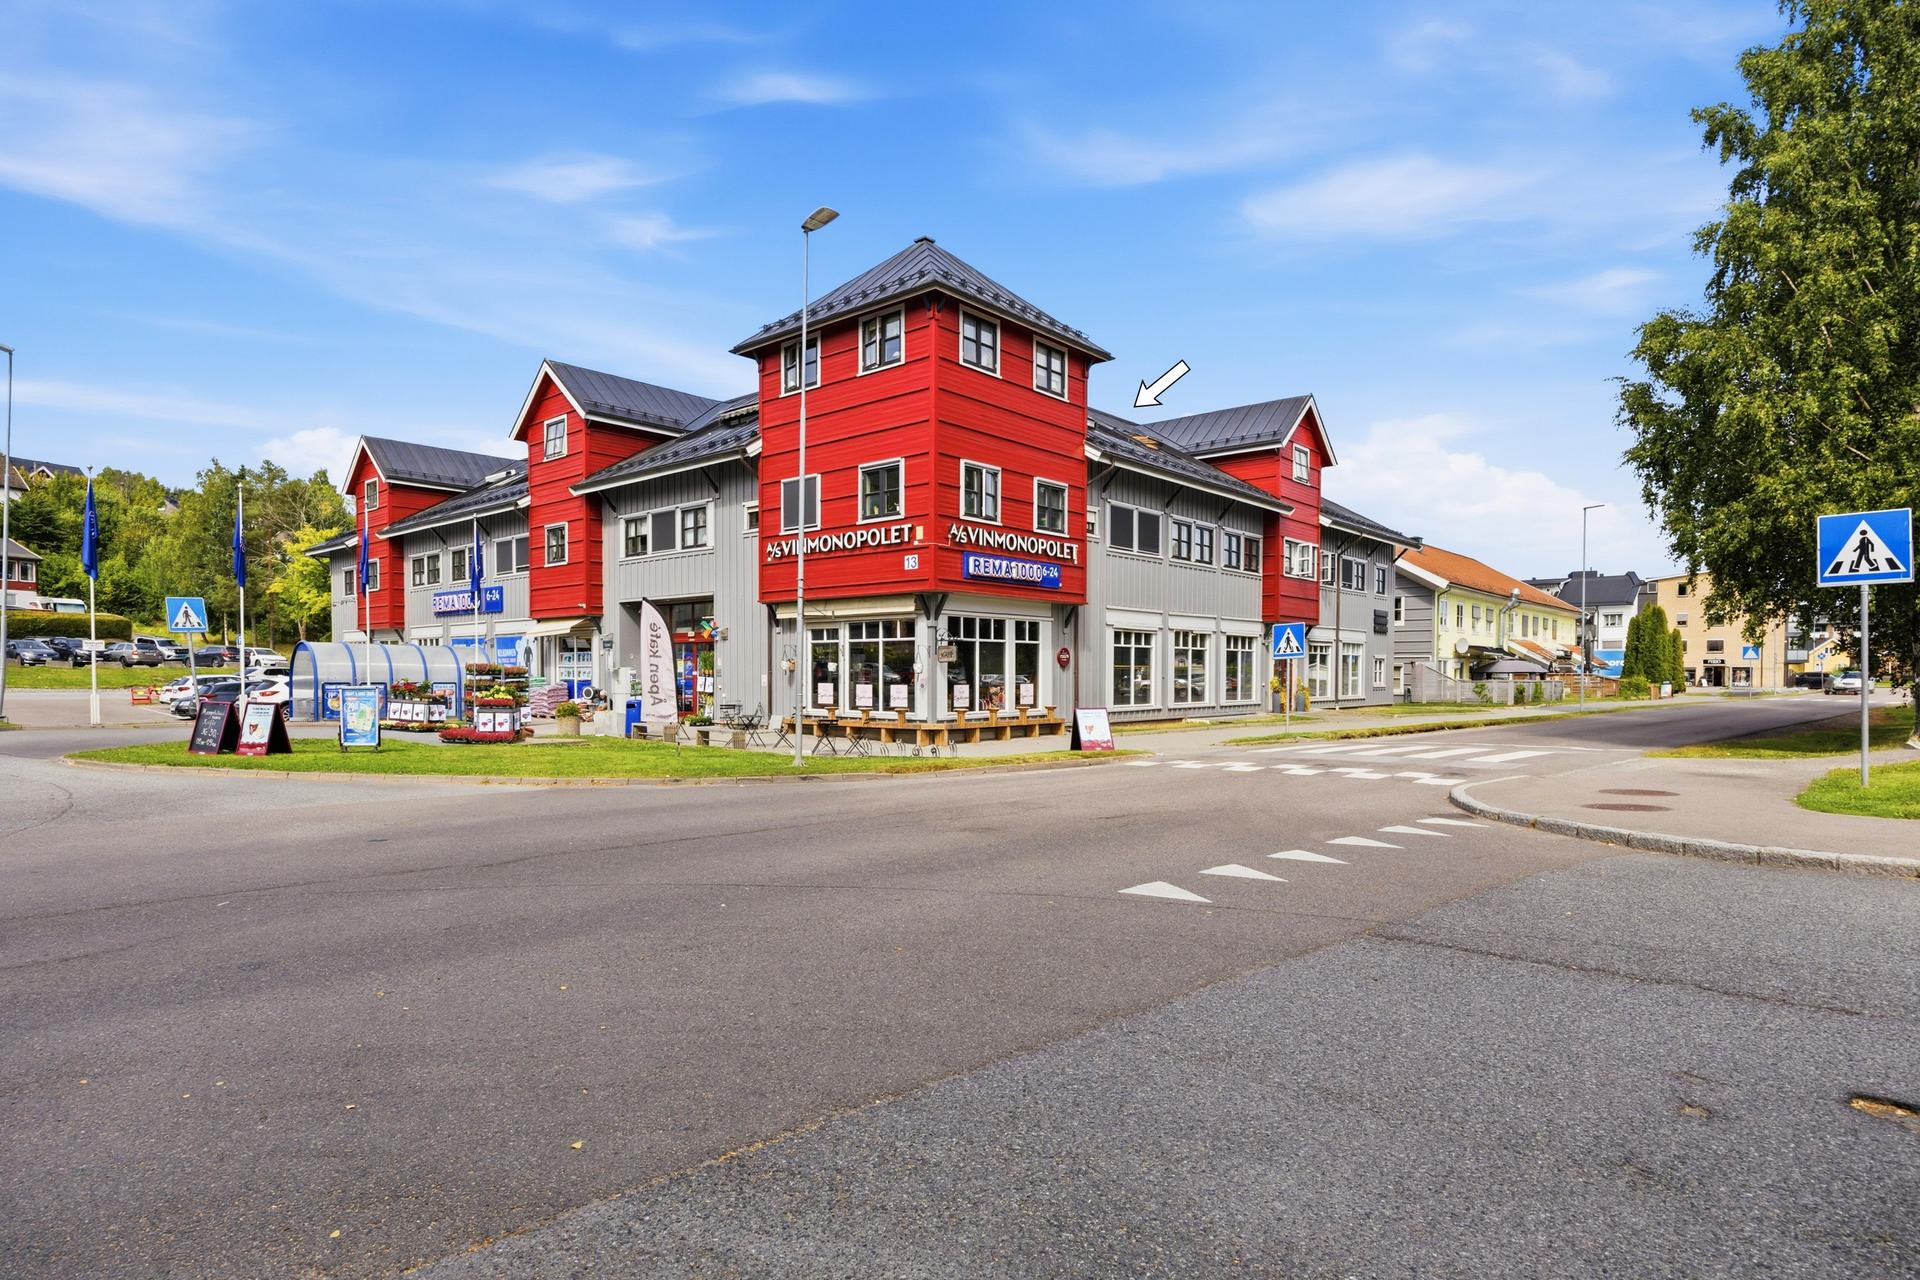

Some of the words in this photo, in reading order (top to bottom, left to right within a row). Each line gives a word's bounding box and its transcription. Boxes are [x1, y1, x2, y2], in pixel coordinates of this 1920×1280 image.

[781, 524, 912, 556] VINMONOPOLET
[967, 526, 1079, 559] VINMONOPOLET
[906, 557, 917, 568] 13
[971, 557, 1012, 577] REMA
[1013, 561, 1043, 581] 1000
[1042, 567, 1059, 578] 6-24
[487, 590, 499, 601] 6-24
